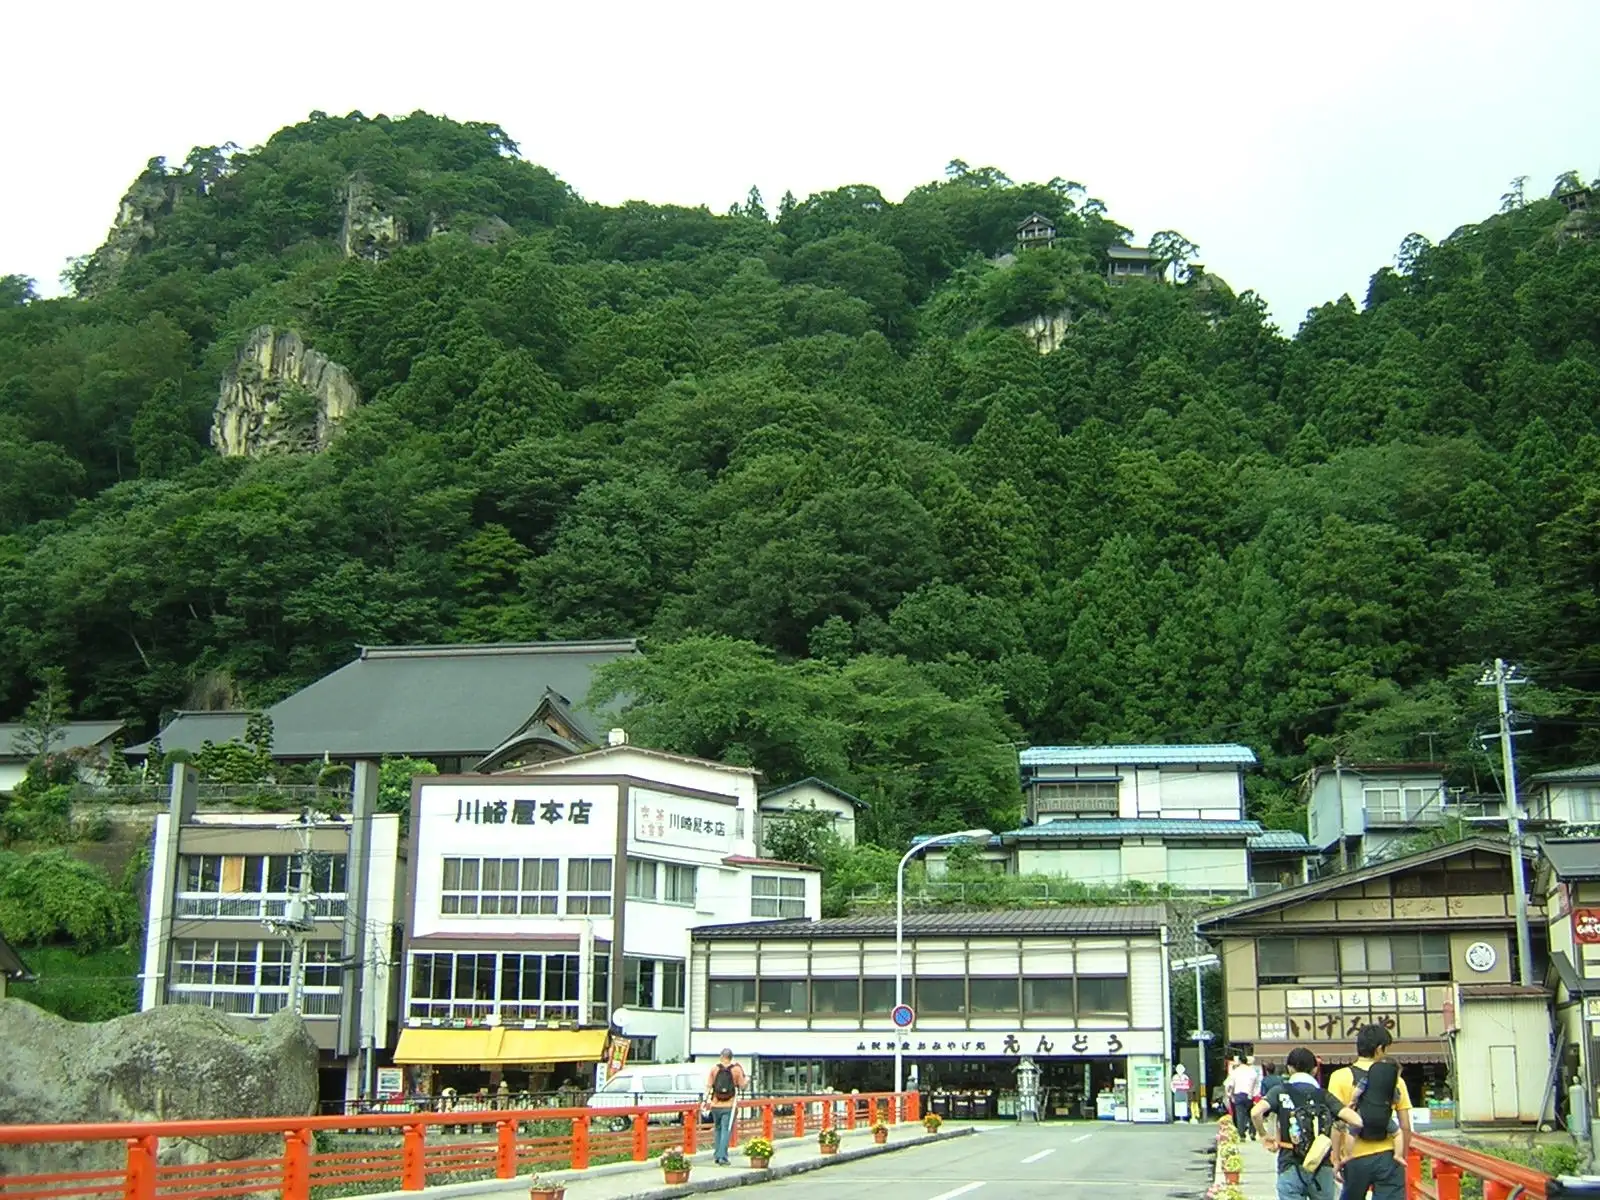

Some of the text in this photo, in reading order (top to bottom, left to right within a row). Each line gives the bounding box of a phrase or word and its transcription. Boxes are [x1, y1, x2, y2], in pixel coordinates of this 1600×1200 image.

[455, 798, 594, 825] 川崎屋本店
[669, 813, 726, 837] 川崎屋本店
[1003, 1034, 1123, 1053] えんどう
